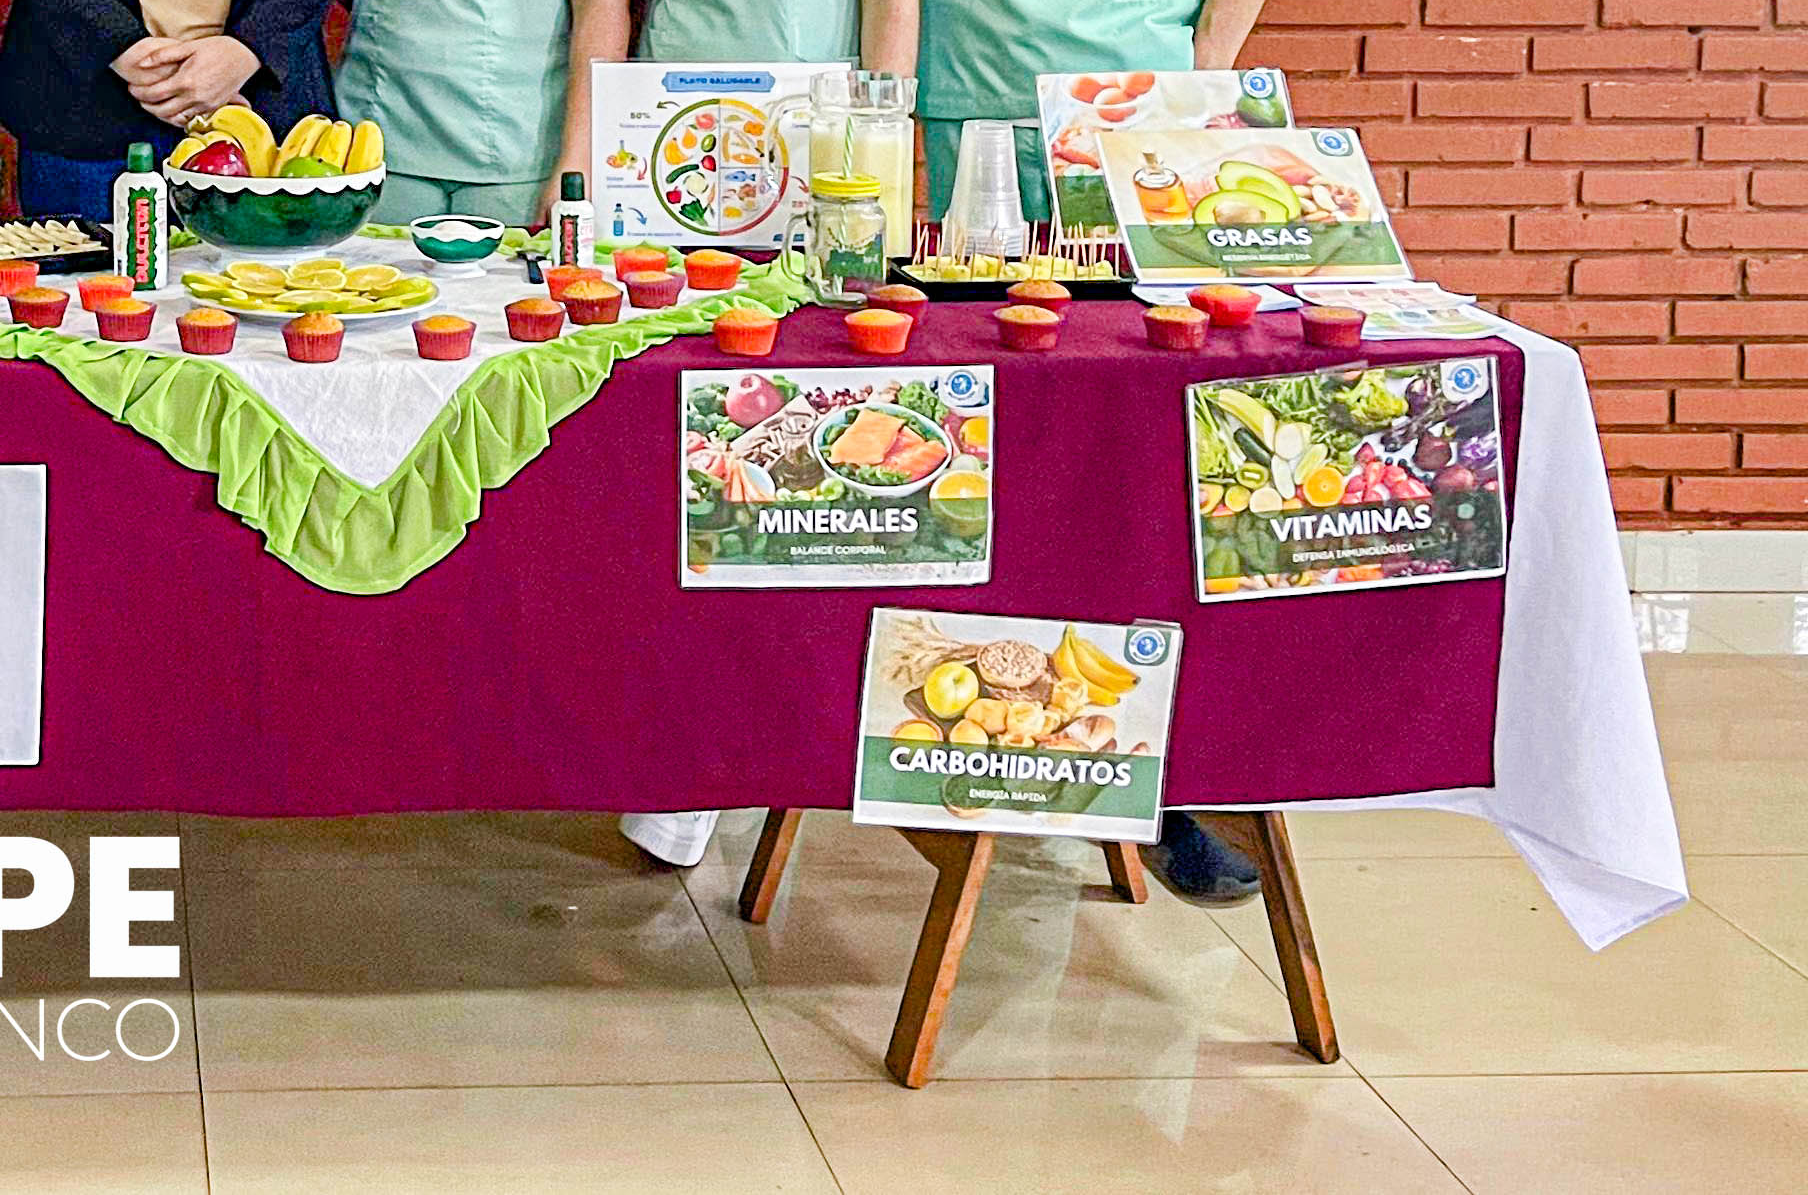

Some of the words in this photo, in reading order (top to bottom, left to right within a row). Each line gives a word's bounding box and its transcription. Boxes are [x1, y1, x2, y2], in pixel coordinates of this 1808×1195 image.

[1207, 227, 1313, 246] GRASAS
[758, 507, 919, 534] MINERALES
[1270, 504, 1432, 542] VITAMINAS
[790, 546, 833, 556] BALANCE
[835, 545, 886, 555] CORPORAL
[1292, 550, 1335, 563] DEFENSA
[889, 746, 1131, 787] CARBOHIDRATOS
